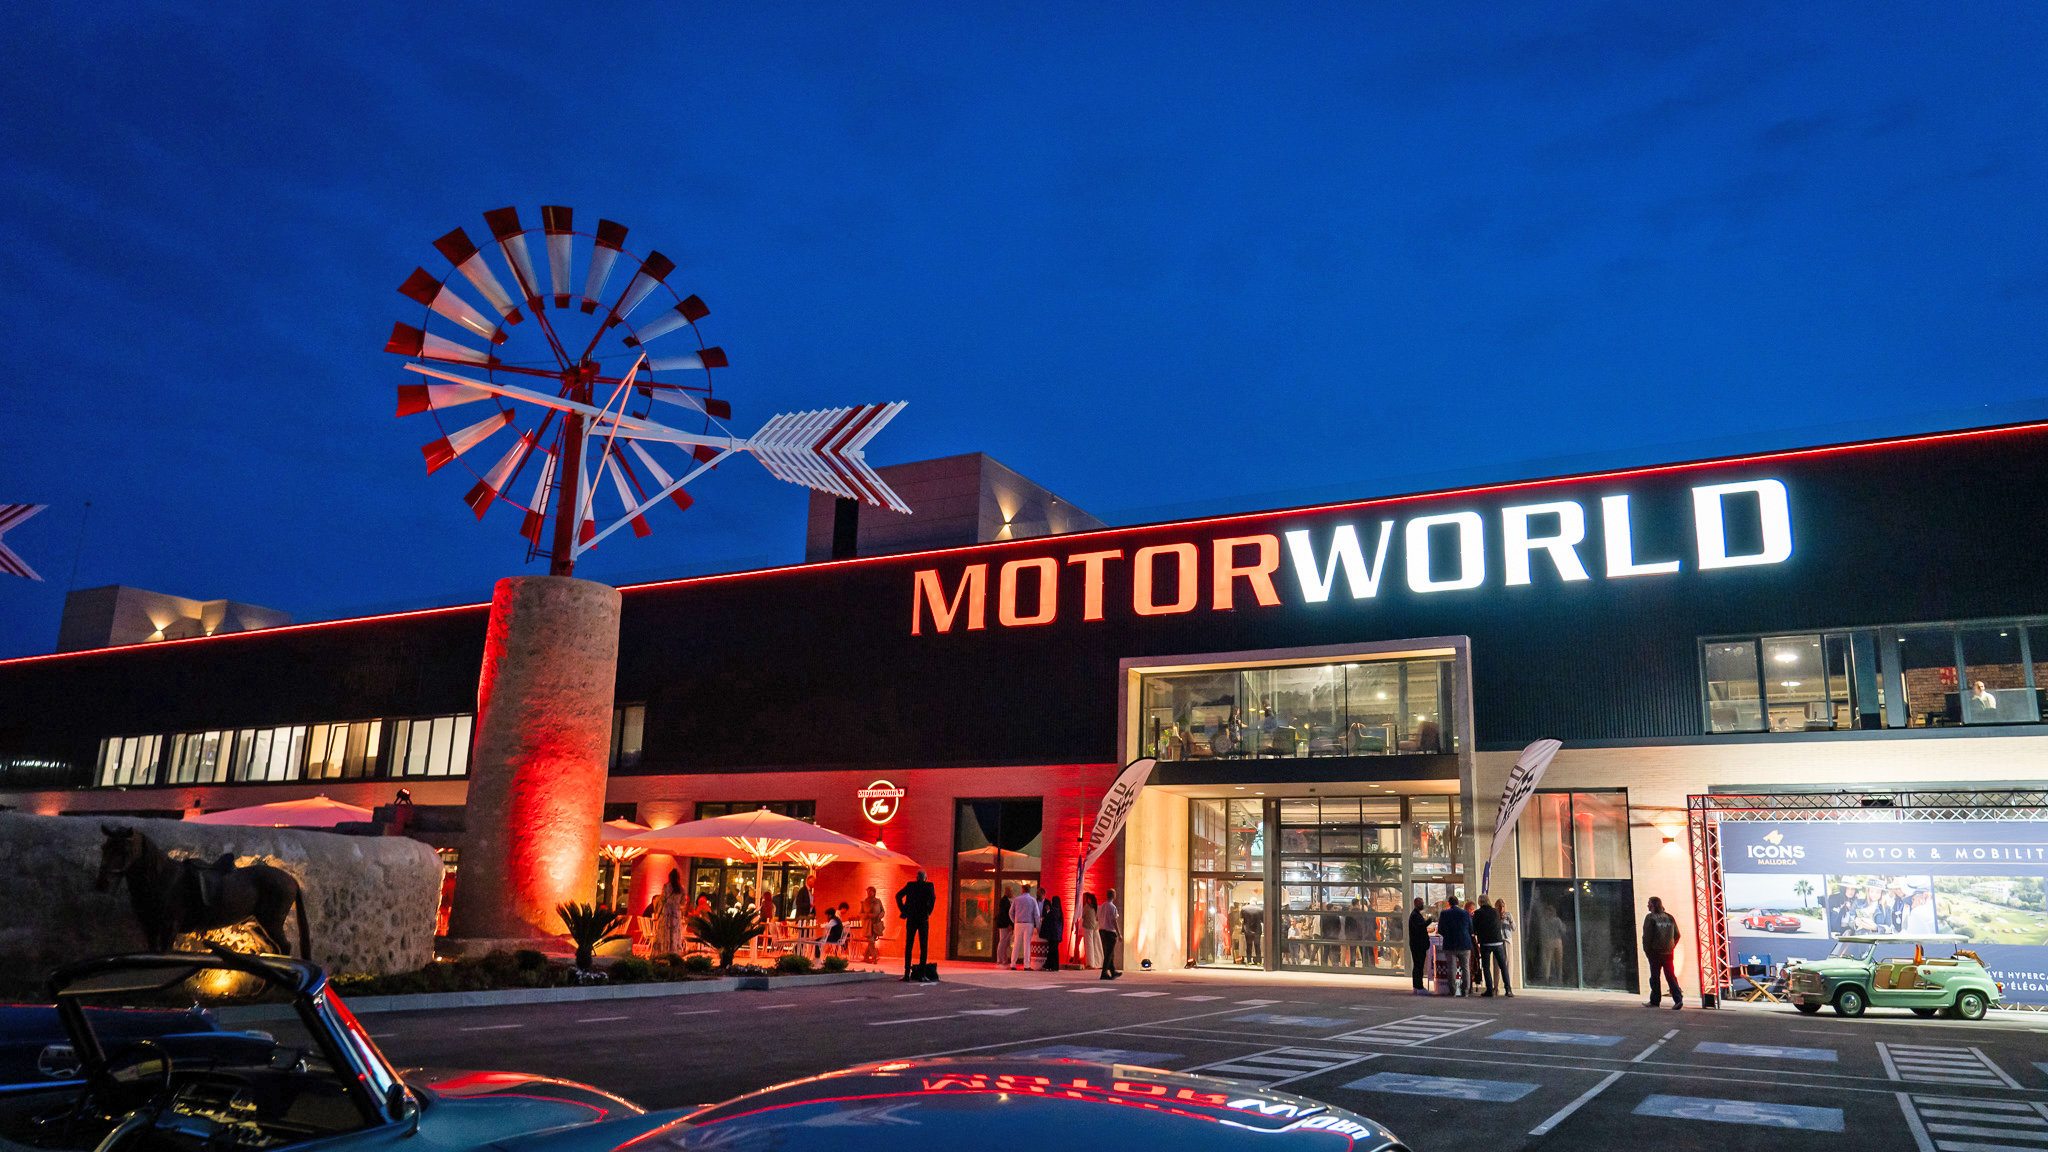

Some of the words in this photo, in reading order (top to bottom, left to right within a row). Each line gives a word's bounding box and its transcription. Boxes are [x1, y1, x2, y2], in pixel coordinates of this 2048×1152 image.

[910, 478, 1795, 636] MOTORWORLD
[1746, 844, 1806, 859] ICONS
[1845, 847, 1916, 859] MOTOR
[1930, 847, 1941, 859] &
[2007, 971, 2048, 980] HYPERC
